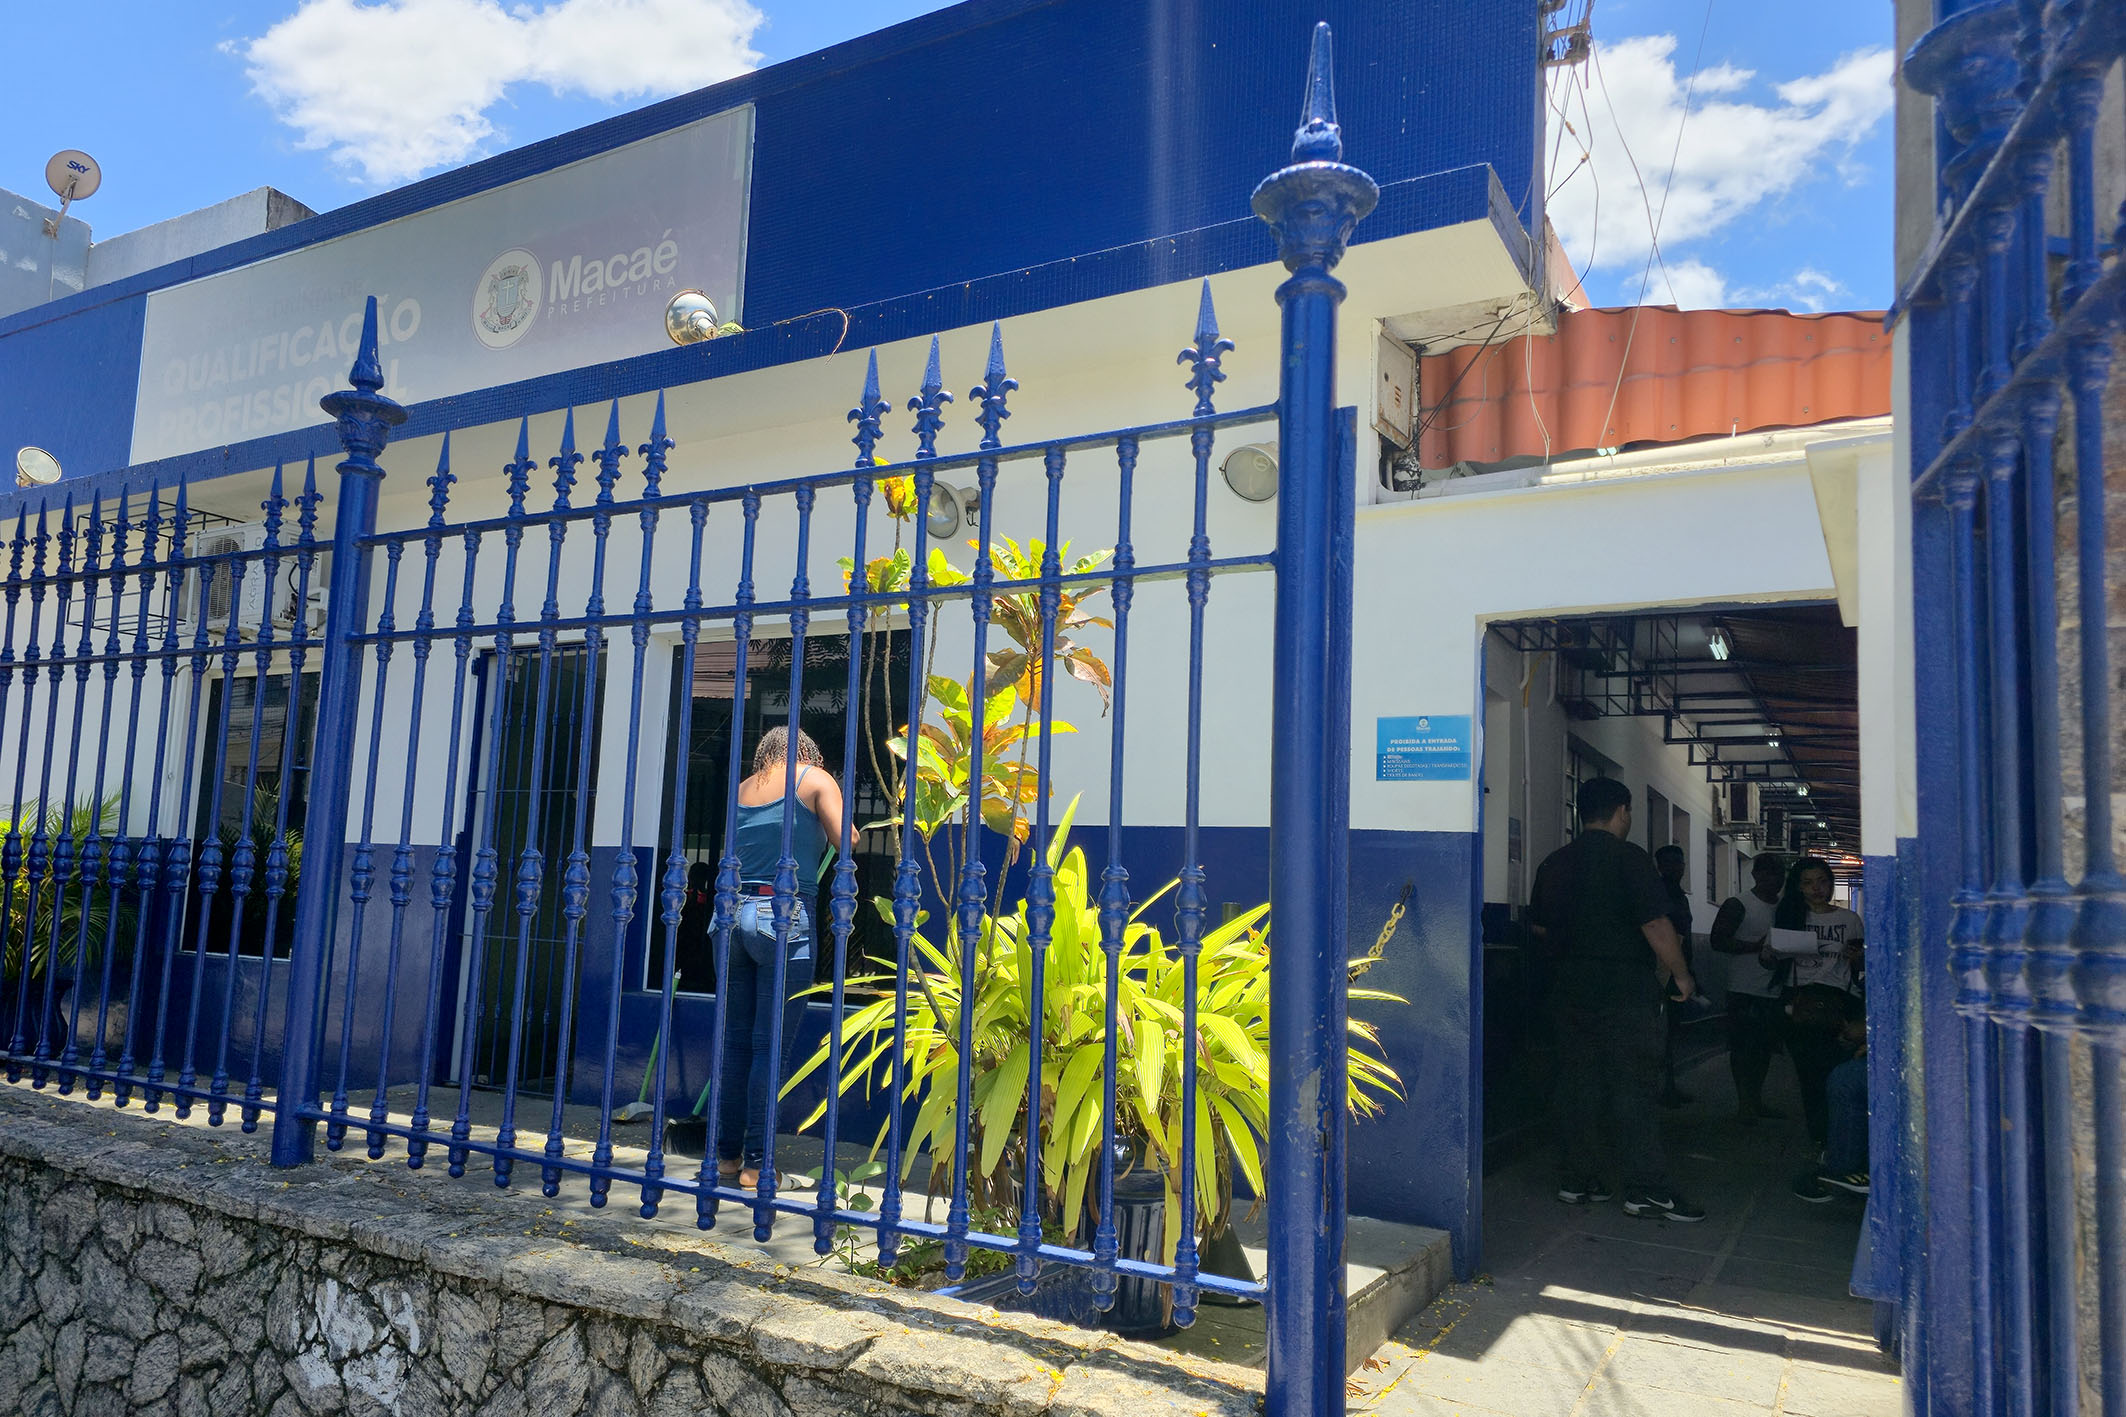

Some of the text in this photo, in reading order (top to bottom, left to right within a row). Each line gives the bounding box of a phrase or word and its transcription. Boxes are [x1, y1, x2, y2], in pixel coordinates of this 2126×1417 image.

[67, 160, 91, 174] SKY
[547, 276, 677, 319] PREFEITURA
[550, 228, 679, 303] Macaé
[156, 358, 408, 447] PROFISSIOL
[247, 536, 262, 610] AGRAO
